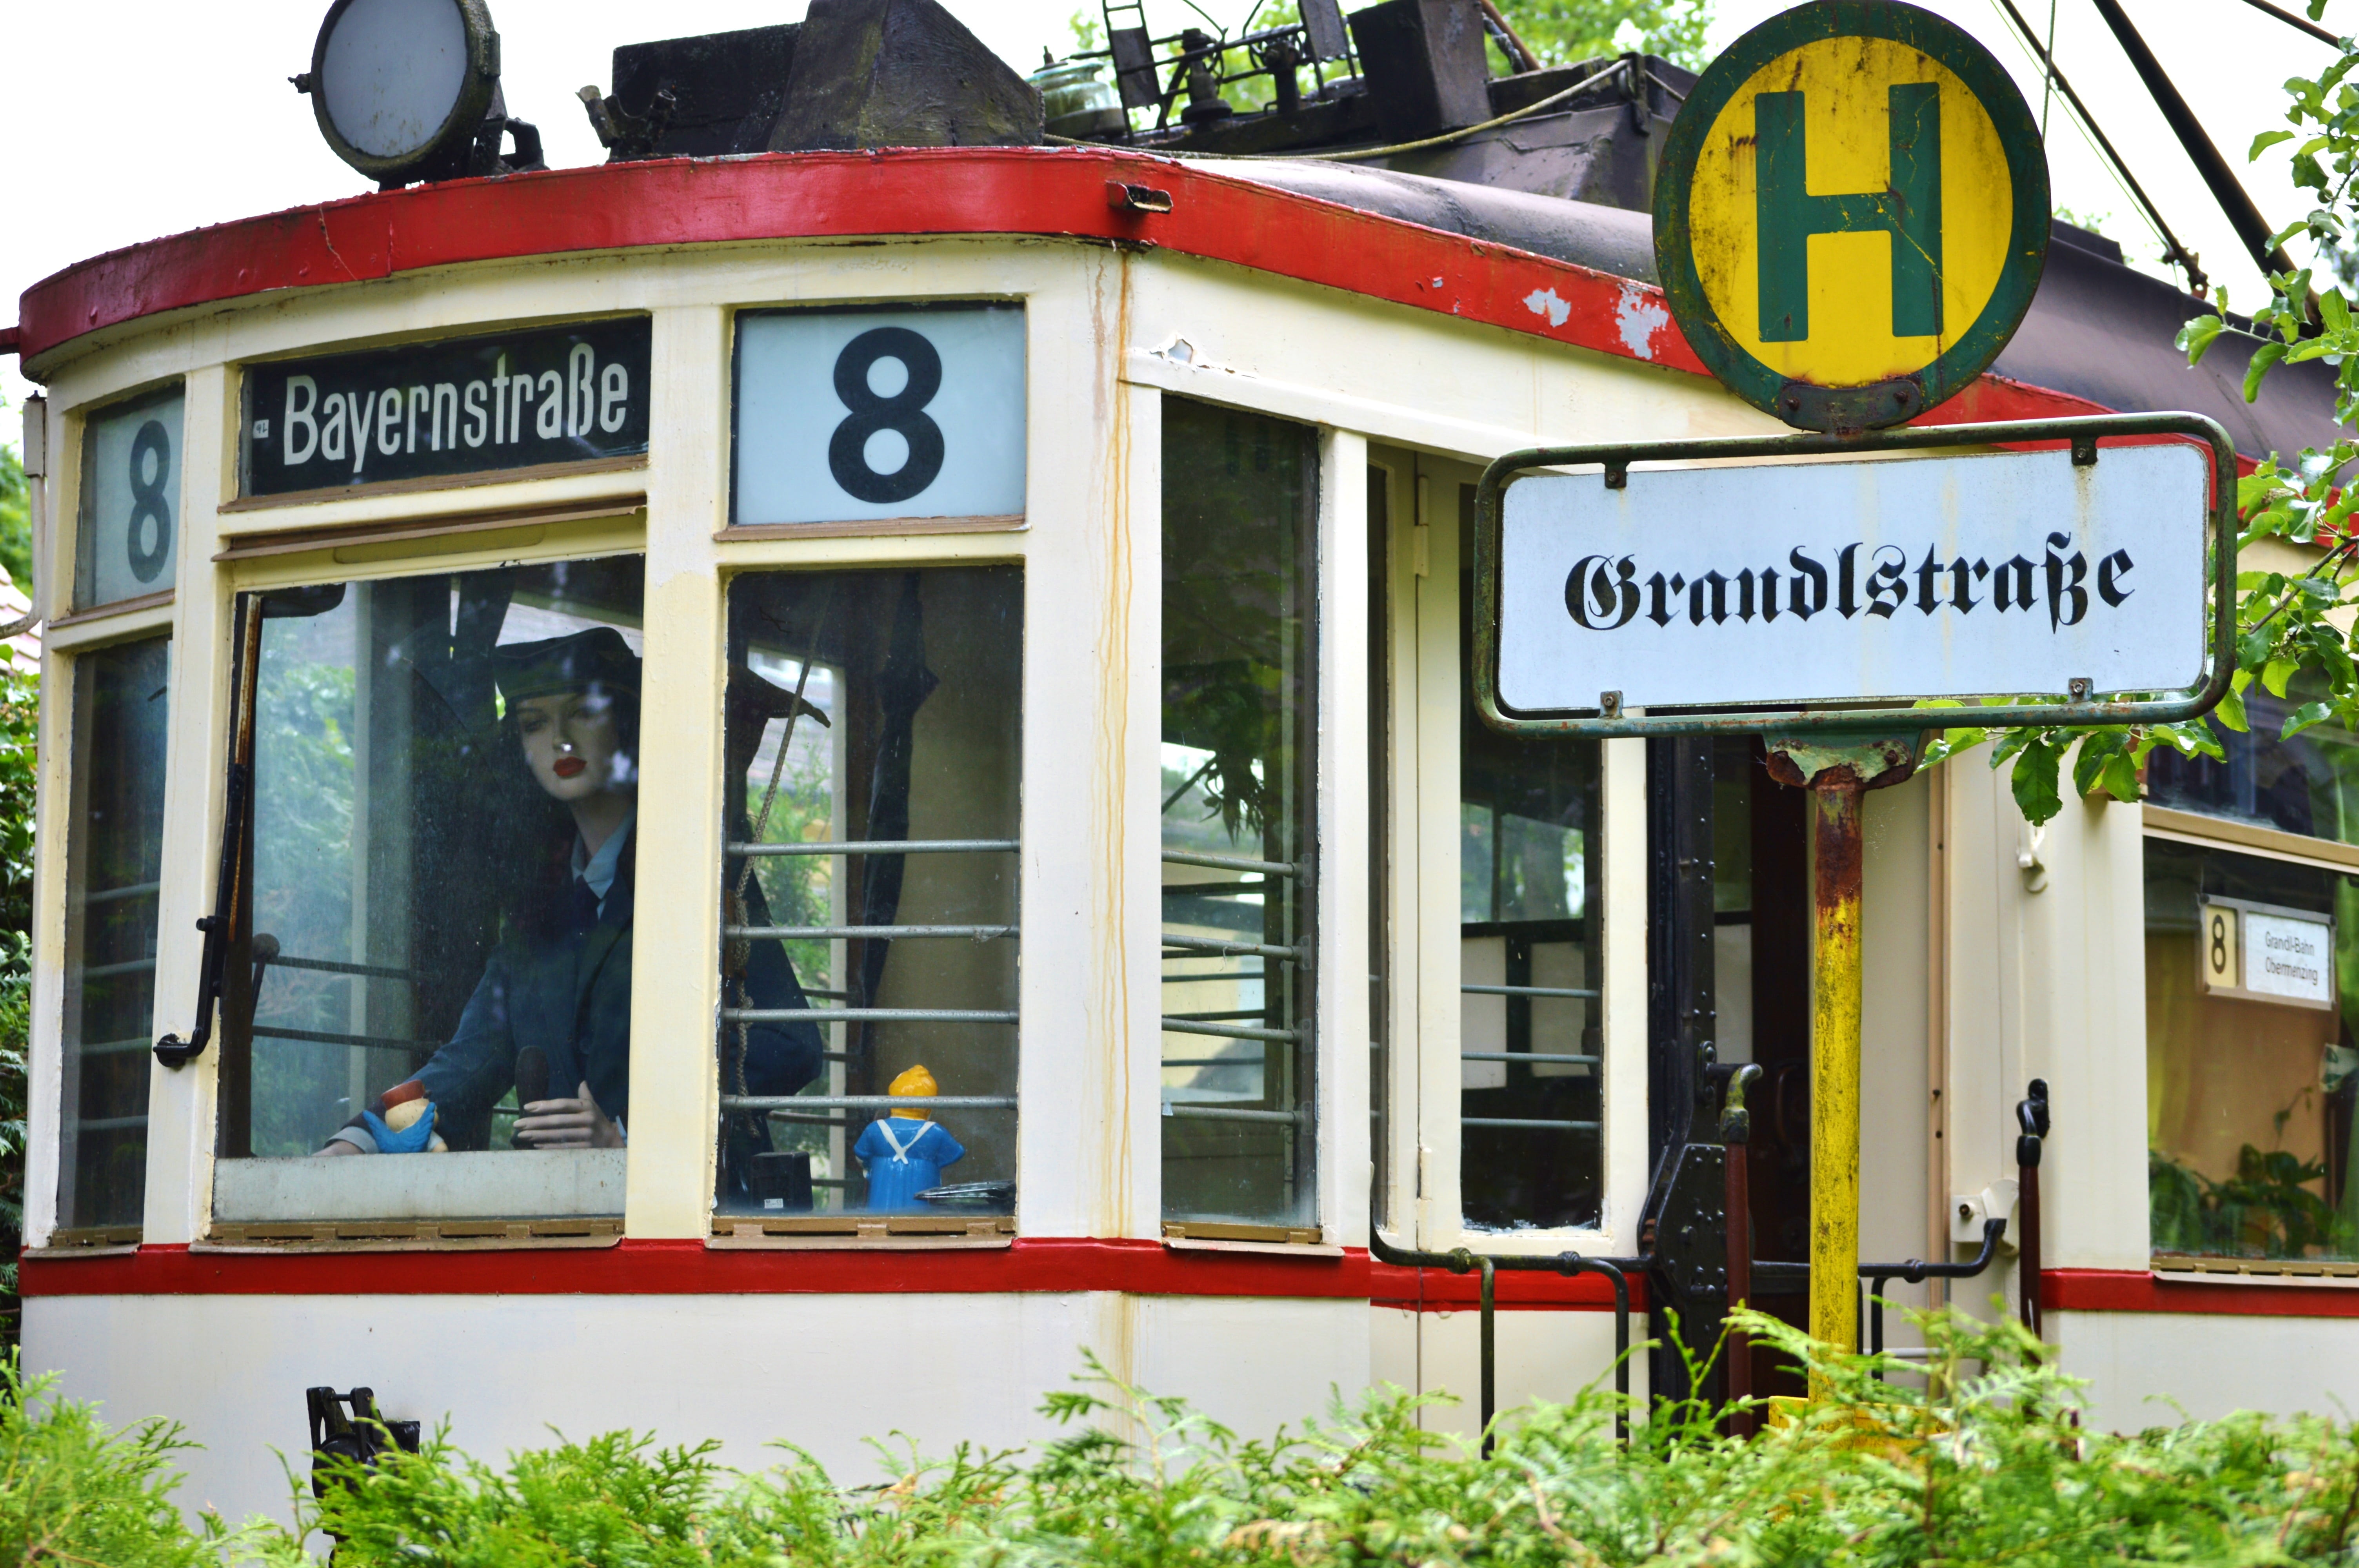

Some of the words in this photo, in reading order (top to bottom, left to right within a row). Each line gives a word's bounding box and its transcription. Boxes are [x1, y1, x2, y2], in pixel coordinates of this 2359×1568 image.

[1754, 82, 1943, 343] H
[283, 342, 628, 473] Bayernstraße
[828, 326, 945, 504] 8
[127, 420, 171, 584] 8
[1564, 532, 2135, 635] Grandlstraße
[2212, 915, 2226, 974] 8
[2265, 931, 2315, 956] Grandl-Bahn
[2265, 957, 2318, 986] Obermenzing
